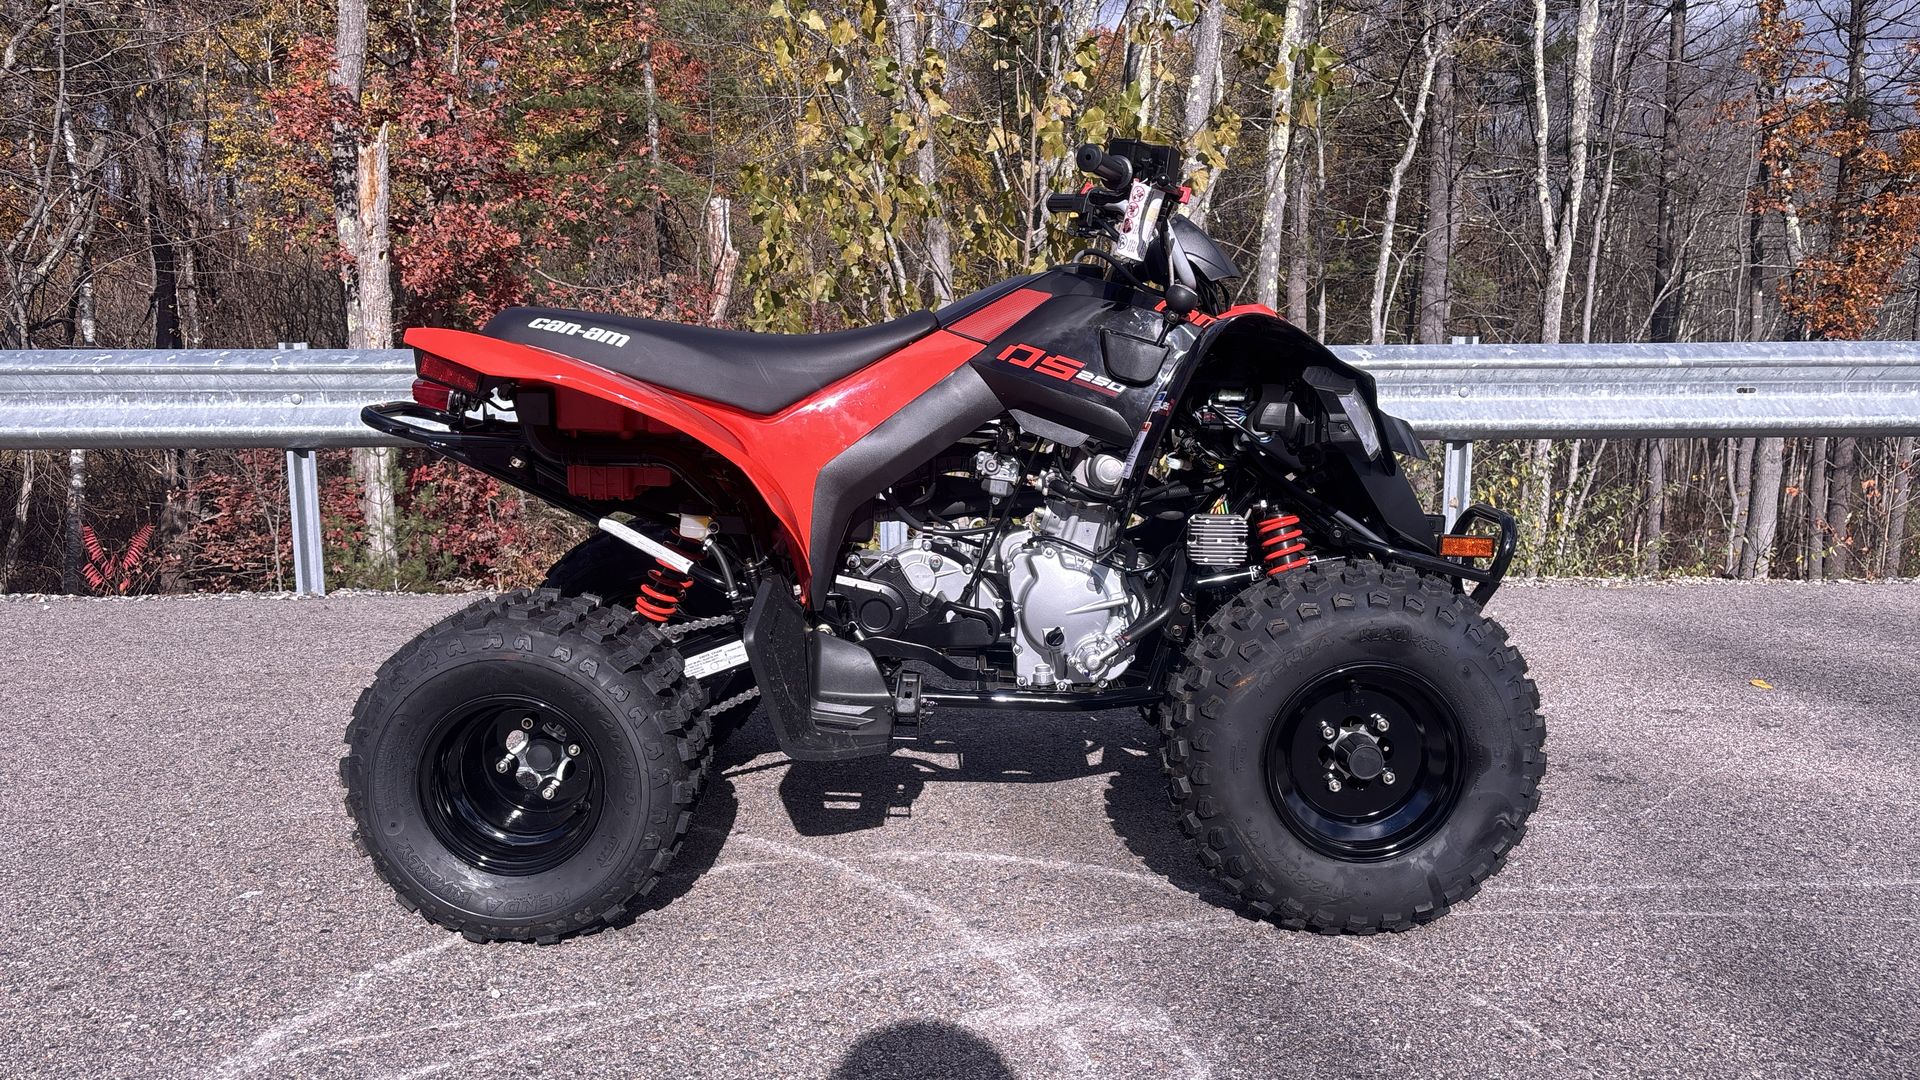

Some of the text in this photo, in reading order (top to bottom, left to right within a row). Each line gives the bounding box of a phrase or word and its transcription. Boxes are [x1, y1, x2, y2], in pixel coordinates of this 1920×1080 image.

[528, 317, 631, 348] can-am
[996, 343, 1127, 393] DS 250
[486, 888, 572, 914] KENDA
